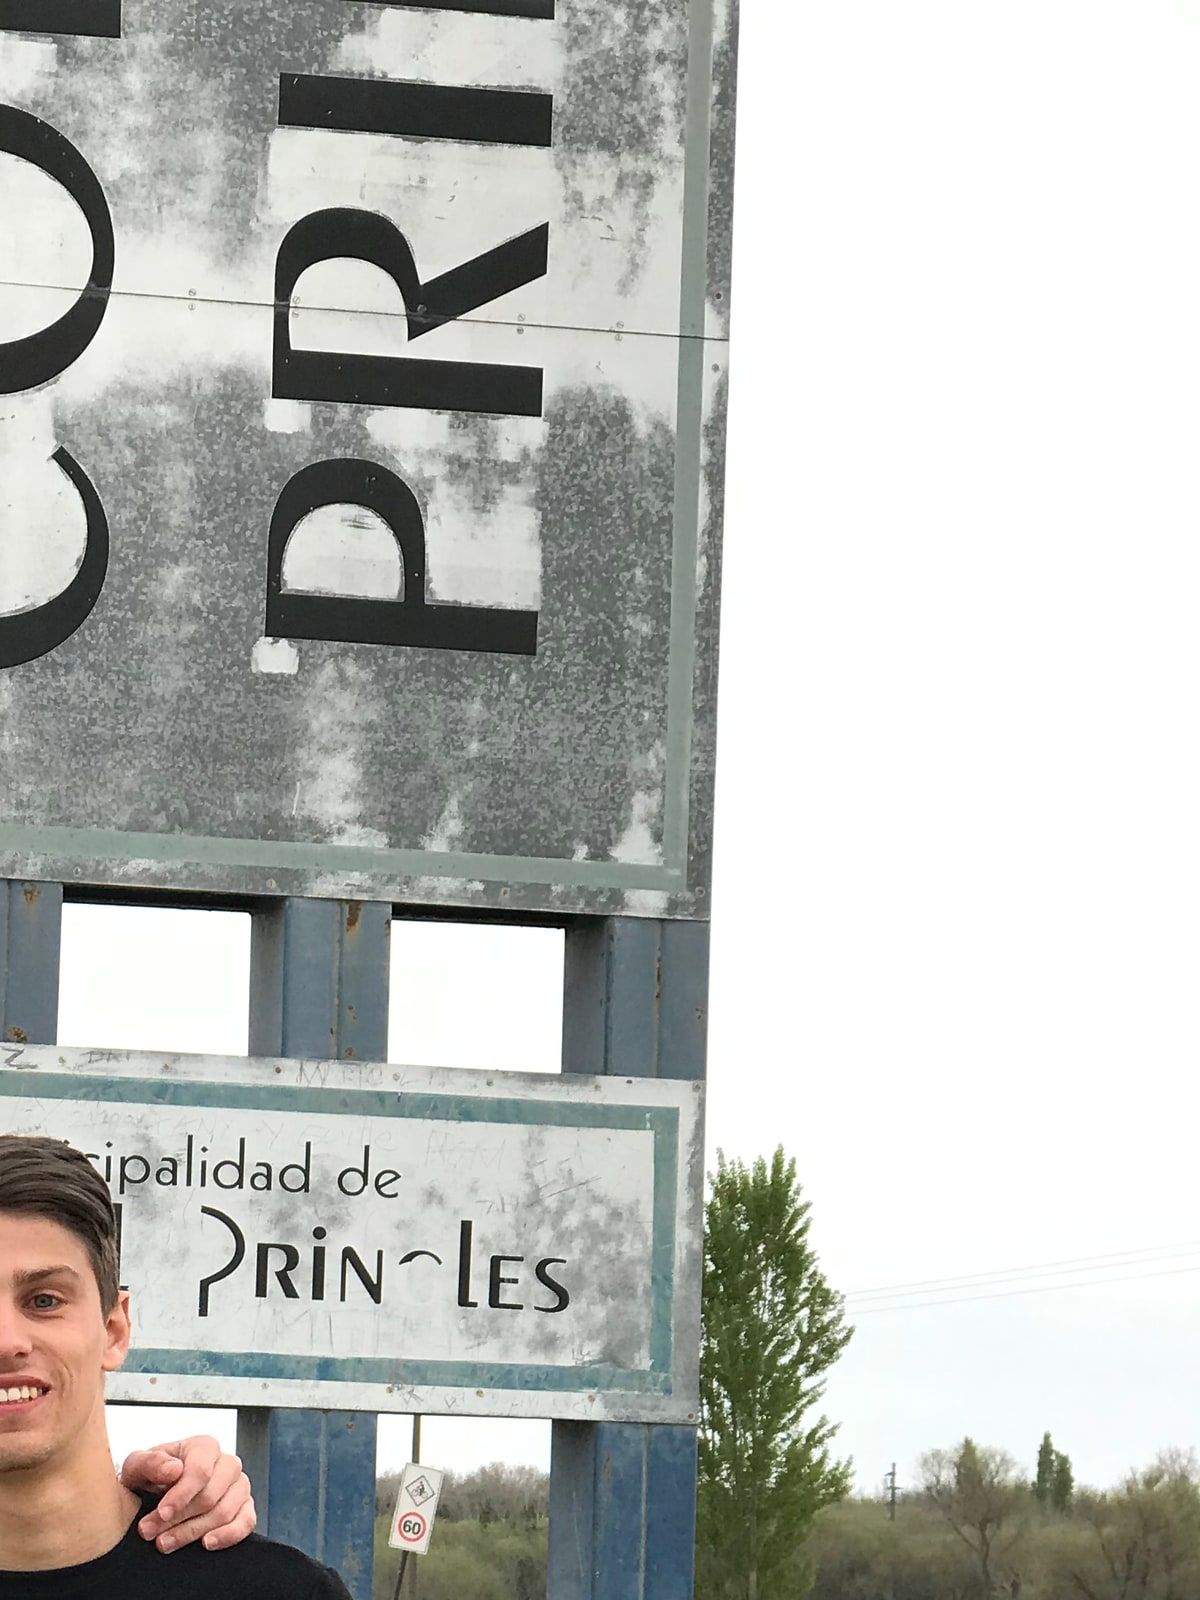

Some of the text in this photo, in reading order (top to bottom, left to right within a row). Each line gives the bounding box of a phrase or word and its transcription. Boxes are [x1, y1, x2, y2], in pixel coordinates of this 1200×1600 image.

[264, 0, 555, 659] PRI
[337, 1145, 402, 1199] de
[403, 1520, 420, 1535] 60
